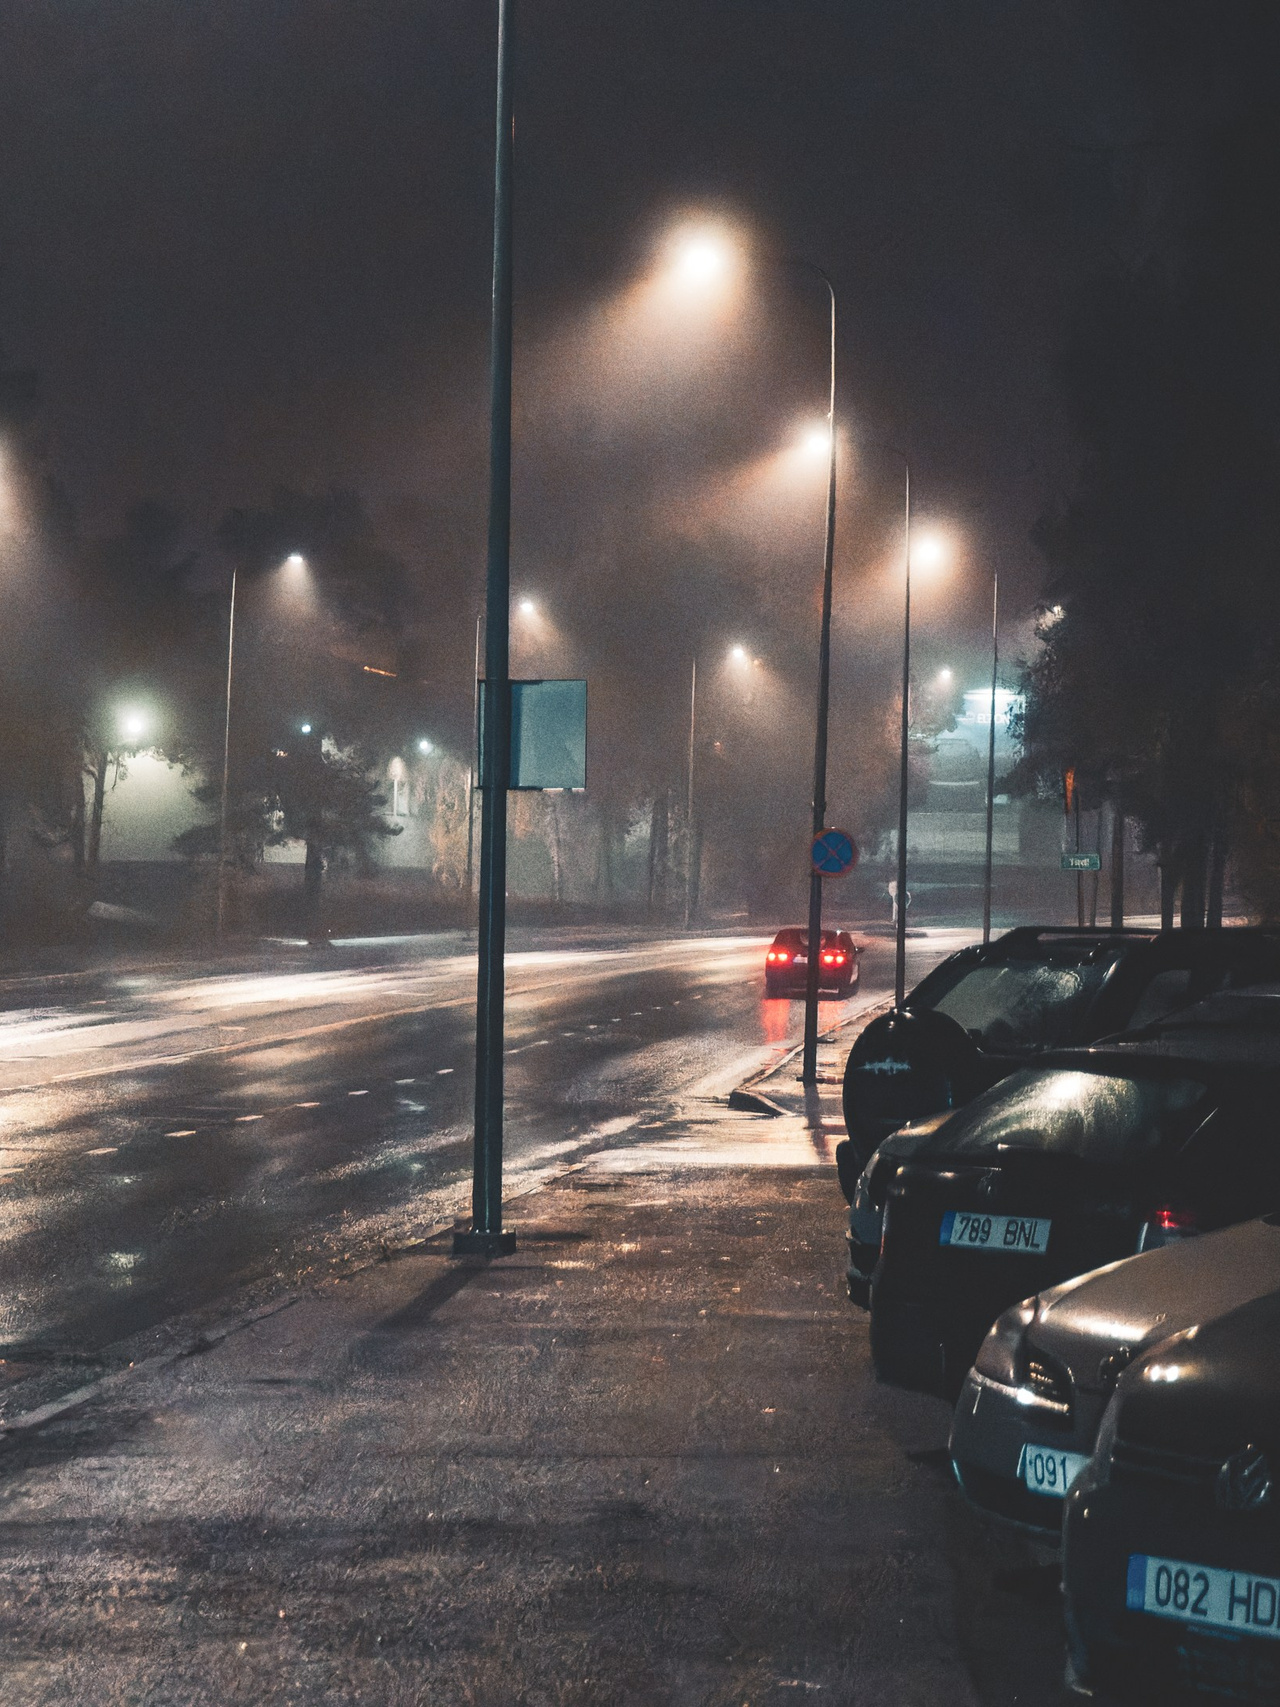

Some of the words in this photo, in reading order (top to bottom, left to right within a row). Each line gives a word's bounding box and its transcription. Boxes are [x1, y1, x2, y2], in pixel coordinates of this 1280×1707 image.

[959, 1216, 992, 1243] 789
[1003, 1219, 1041, 1249] BNL
[1034, 1453, 1067, 1491] 091
[1155, 1564, 1210, 1617] 082
[1227, 1571, 1280, 1629] HD
